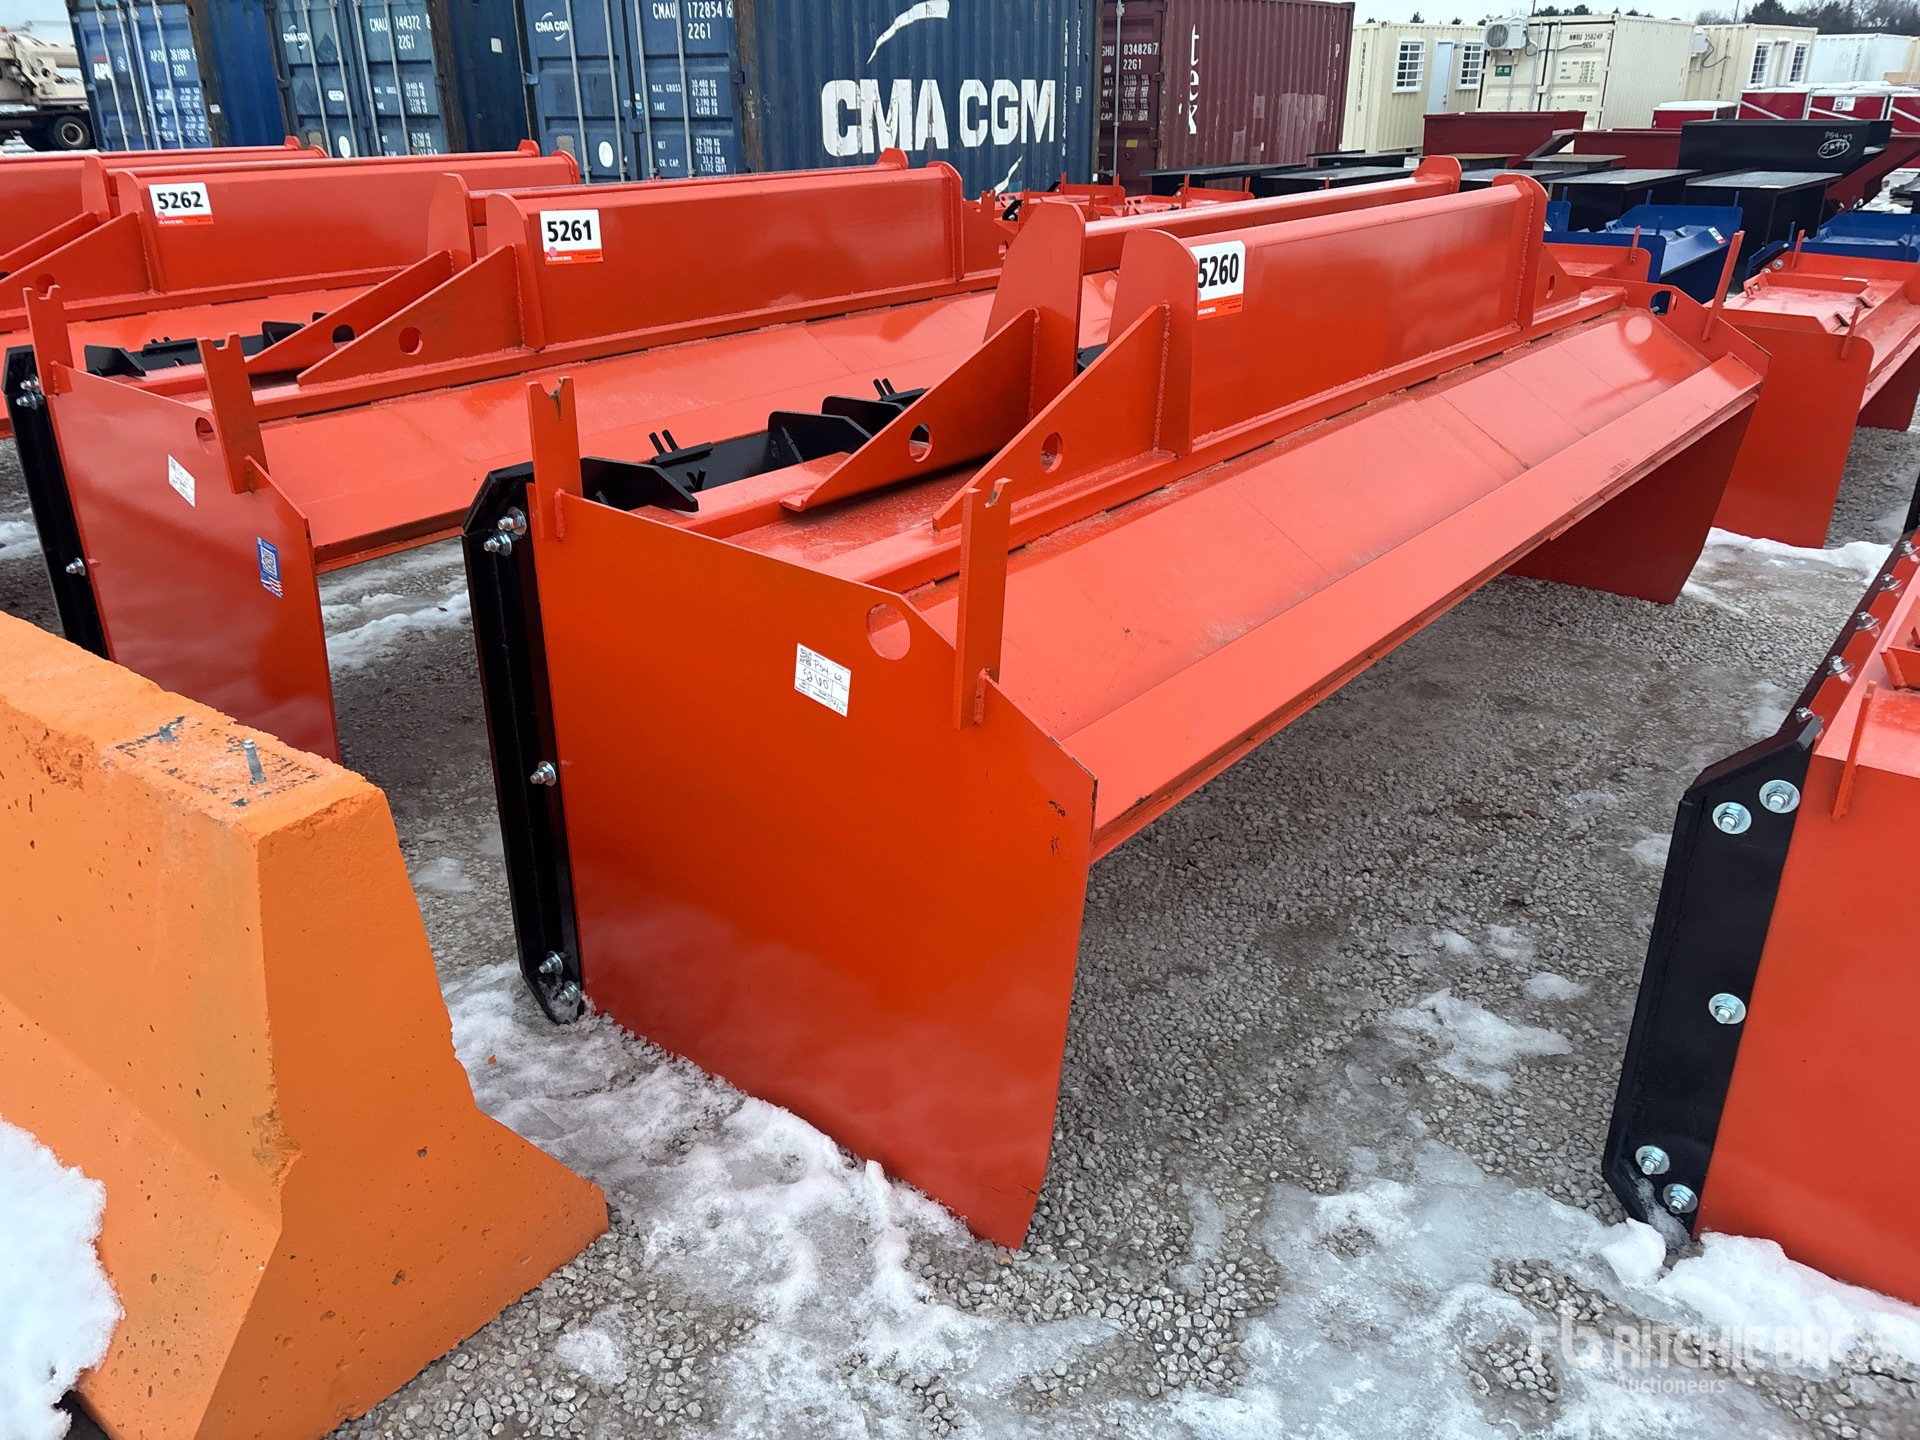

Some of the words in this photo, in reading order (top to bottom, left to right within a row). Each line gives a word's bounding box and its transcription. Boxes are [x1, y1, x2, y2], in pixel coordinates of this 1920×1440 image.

[653, 2, 676, 20] CMAU
[687, 1, 722, 19] 172854
[726, 1, 733, 18] 6
[369, 17, 388, 33] CMAU
[395, 14, 422, 31] 144372
[535, 21, 554, 33] CMA
[687, 22, 711, 39] 22G1
[283, 32, 299, 43] CMA
[397, 34, 415, 50] 22G1
[1584, 33, 1603, 41] 358249
[1123, 43, 1152, 56] 034826
[1123, 58, 1142, 71] 22G1
[665, 83, 682, 93] GROSS
[821, 79, 949, 157] CMA
[959, 79, 1056, 147] CGM
[156, 190, 204, 210] 5262
[547, 219, 592, 243] 5261
[1198, 252, 1239, 289] 5260
